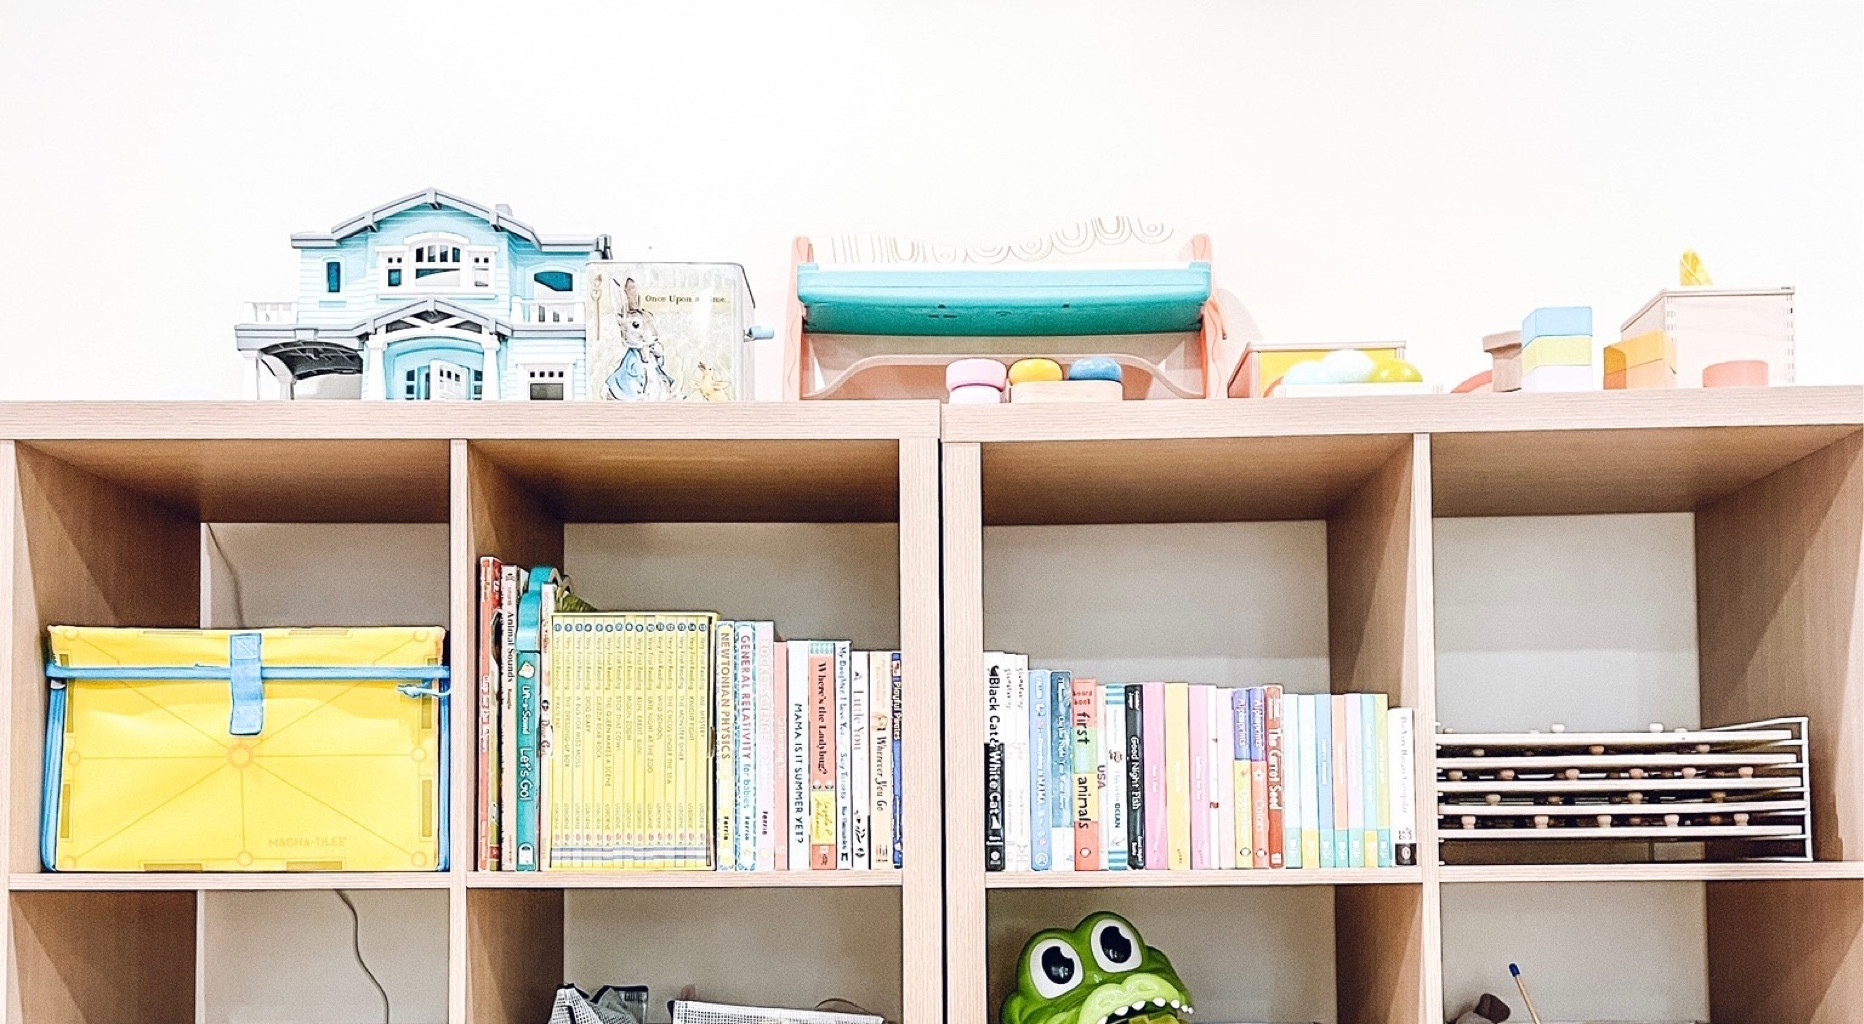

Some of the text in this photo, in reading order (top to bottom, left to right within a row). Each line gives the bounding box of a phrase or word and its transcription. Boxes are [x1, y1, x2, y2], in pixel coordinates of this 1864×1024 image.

[645, 294, 666, 302] Once
[669, 295, 692, 304] Upon
[507, 611, 515, 646] Animal
[506, 648, 515, 683] Sounds
[760, 641, 770, 685] ROCKET
[838, 646, 846, 658] My
[522, 685, 532, 735] Lift-a-Sound
[720, 632, 731, 759] NEWTONIAN PHYSICS
[892, 682, 902, 740] Playful Pirates
[989, 677, 1000, 711] Black
[741, 635, 752, 809] GENERAL RELATIVITY for babies
[760, 690, 770, 740] SCIENCE
[816, 662, 828, 775] Where's the Ladybug?
[853, 690, 864, 750] Little You
[989, 715, 1000, 737] Cat
[1076, 712, 1090, 745] first
[1236, 698, 1246, 746] Alphaprints
[1252, 700, 1262, 748] Alphaprints
[1400, 716, 1408, 728] The
[1268, 728, 1281, 747] The
[519, 748, 533, 801] Let's Go!
[794, 703, 804, 844] MAMA IS IT SUMMER YET?
[875, 736, 888, 811] Wherever You Go
[989, 750, 1001, 789] White
[1097, 765, 1106, 790] USA
[1130, 736, 1141, 810] Good Night Fish
[1268, 750, 1281, 782] Carrot
[989, 792, 1001, 814] Cat
[1037, 778, 1046, 804] MAMA
[1078, 777, 1092, 829] animals
[1269, 785, 1283, 810] Seed
